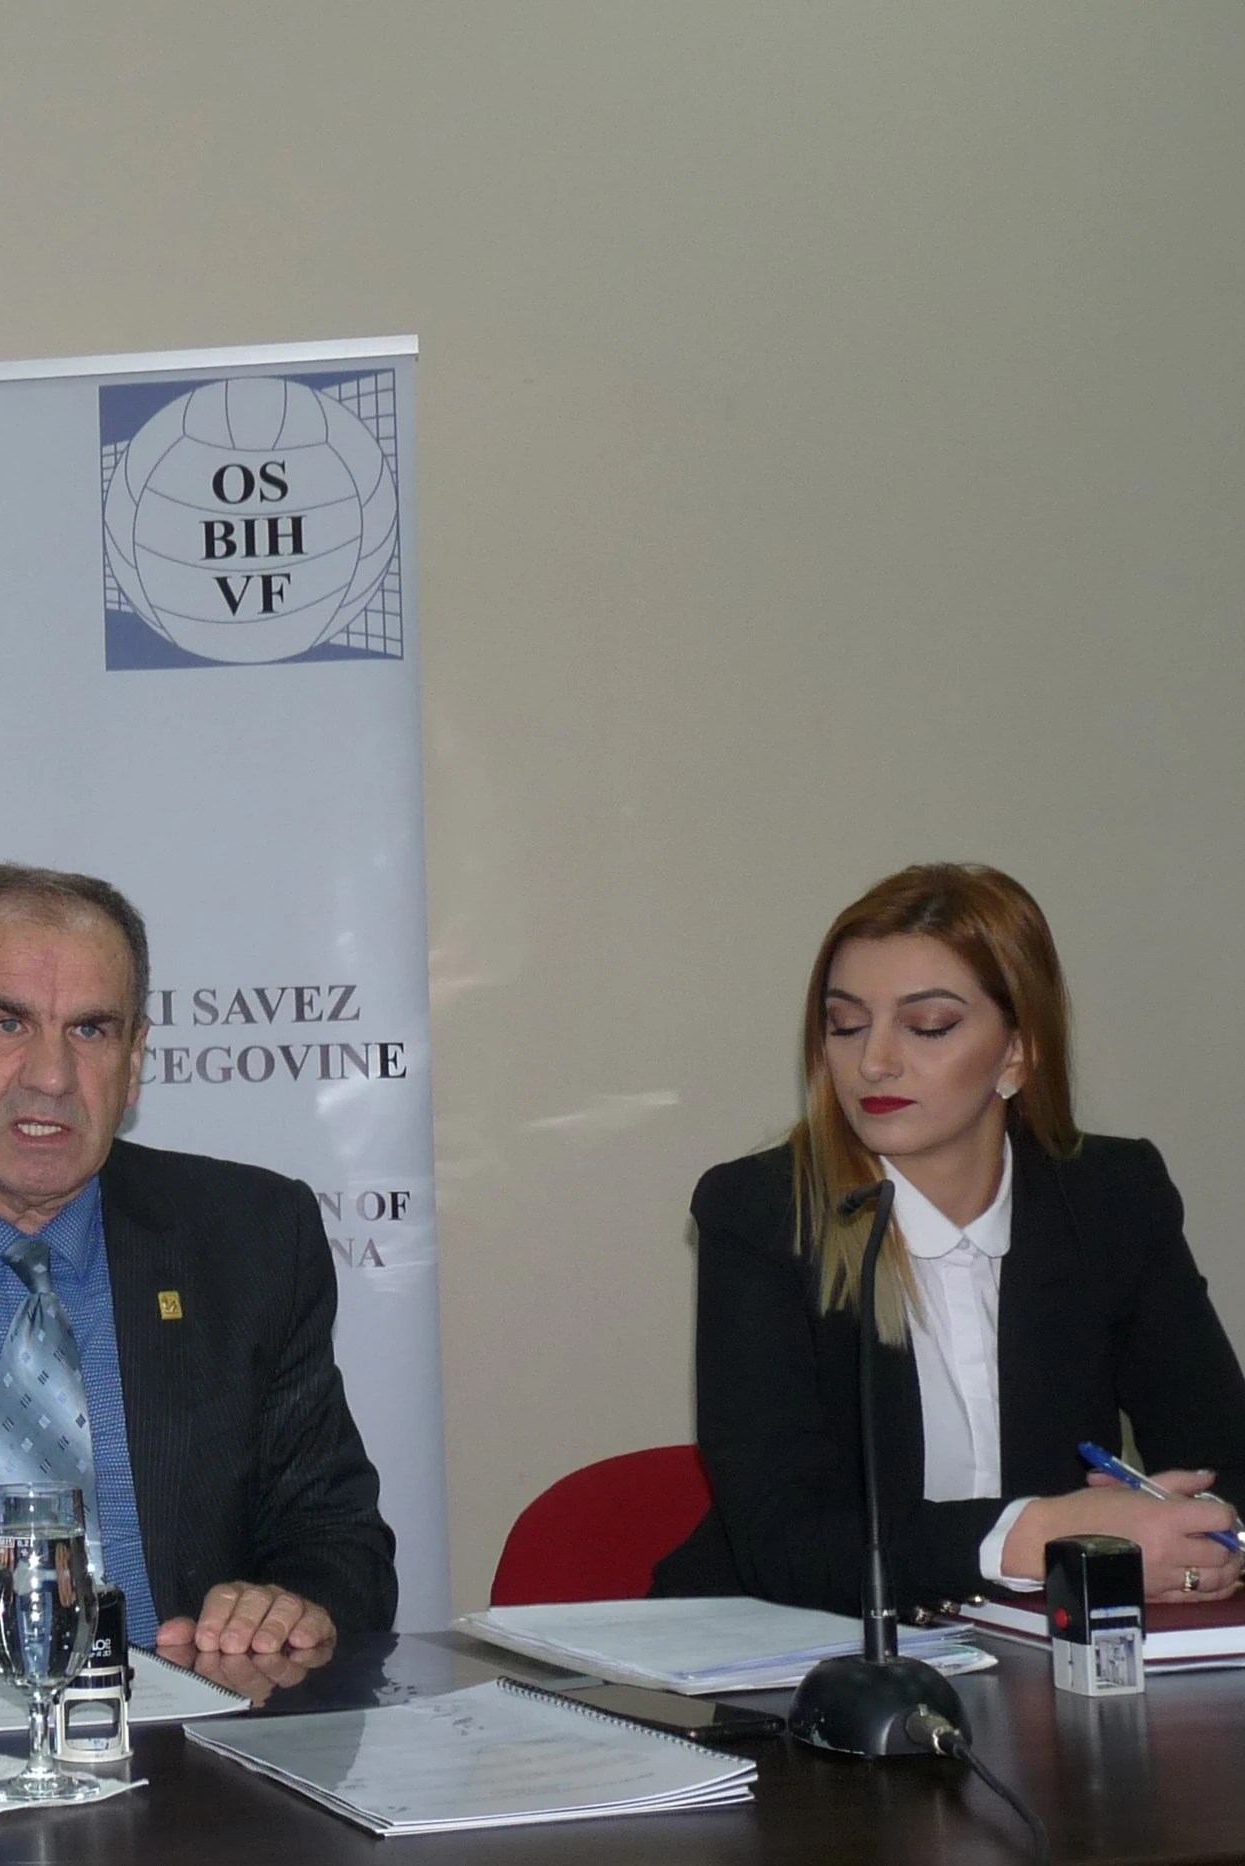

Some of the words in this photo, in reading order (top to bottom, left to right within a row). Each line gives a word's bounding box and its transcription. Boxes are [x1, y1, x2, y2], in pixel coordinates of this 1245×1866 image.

[212, 460, 289, 505] OS
[199, 515, 308, 561] BIH
[212, 572, 291, 616] VF
[192, 984, 361, 1027] SAVEZ
[356, 1190, 411, 1222] OF
